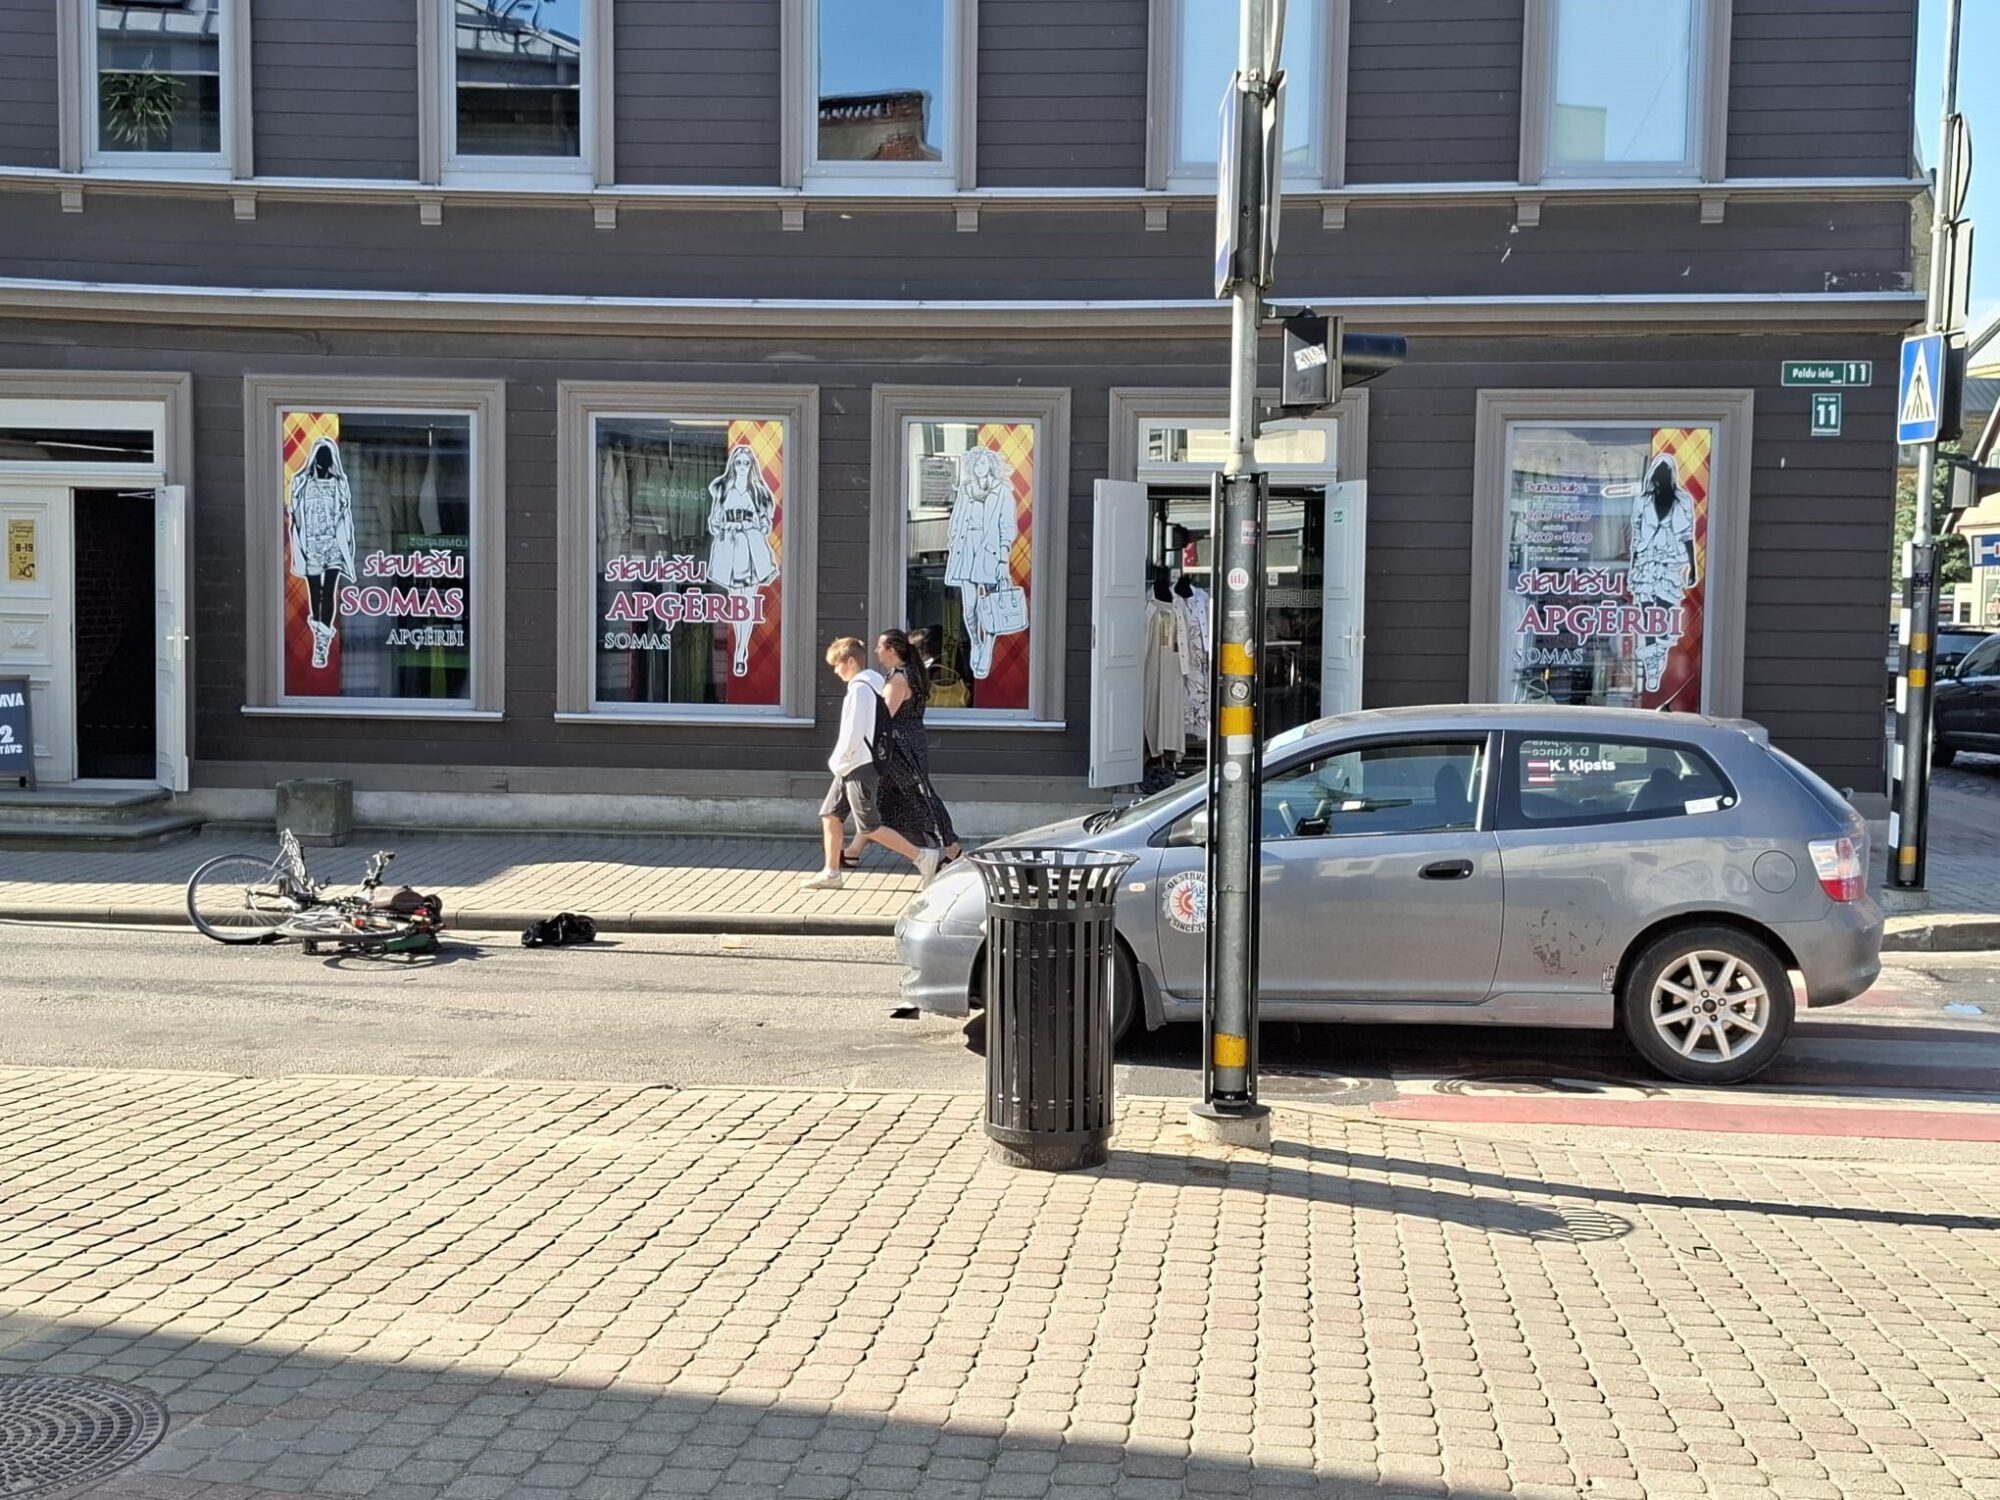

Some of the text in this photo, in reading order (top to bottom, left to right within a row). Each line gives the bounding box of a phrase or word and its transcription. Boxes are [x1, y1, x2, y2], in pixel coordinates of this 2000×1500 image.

[1818, 367, 1834, 378] iela
[1848, 363, 1866, 382] 11
[1816, 403, 1837, 425] 11
[340, 586, 464, 618] SOMAS
[605, 588, 766, 631] APĢĒRBI
[1516, 601, 1684, 645] APĢĒRBI
[386, 626, 464, 650] APĢĒRBI
[604, 632, 671, 650] SOMAS
[1513, 648, 1583, 665] SOMAS
[0, 724, 15, 744] 2
[1549, 759, 1566, 771] K.
